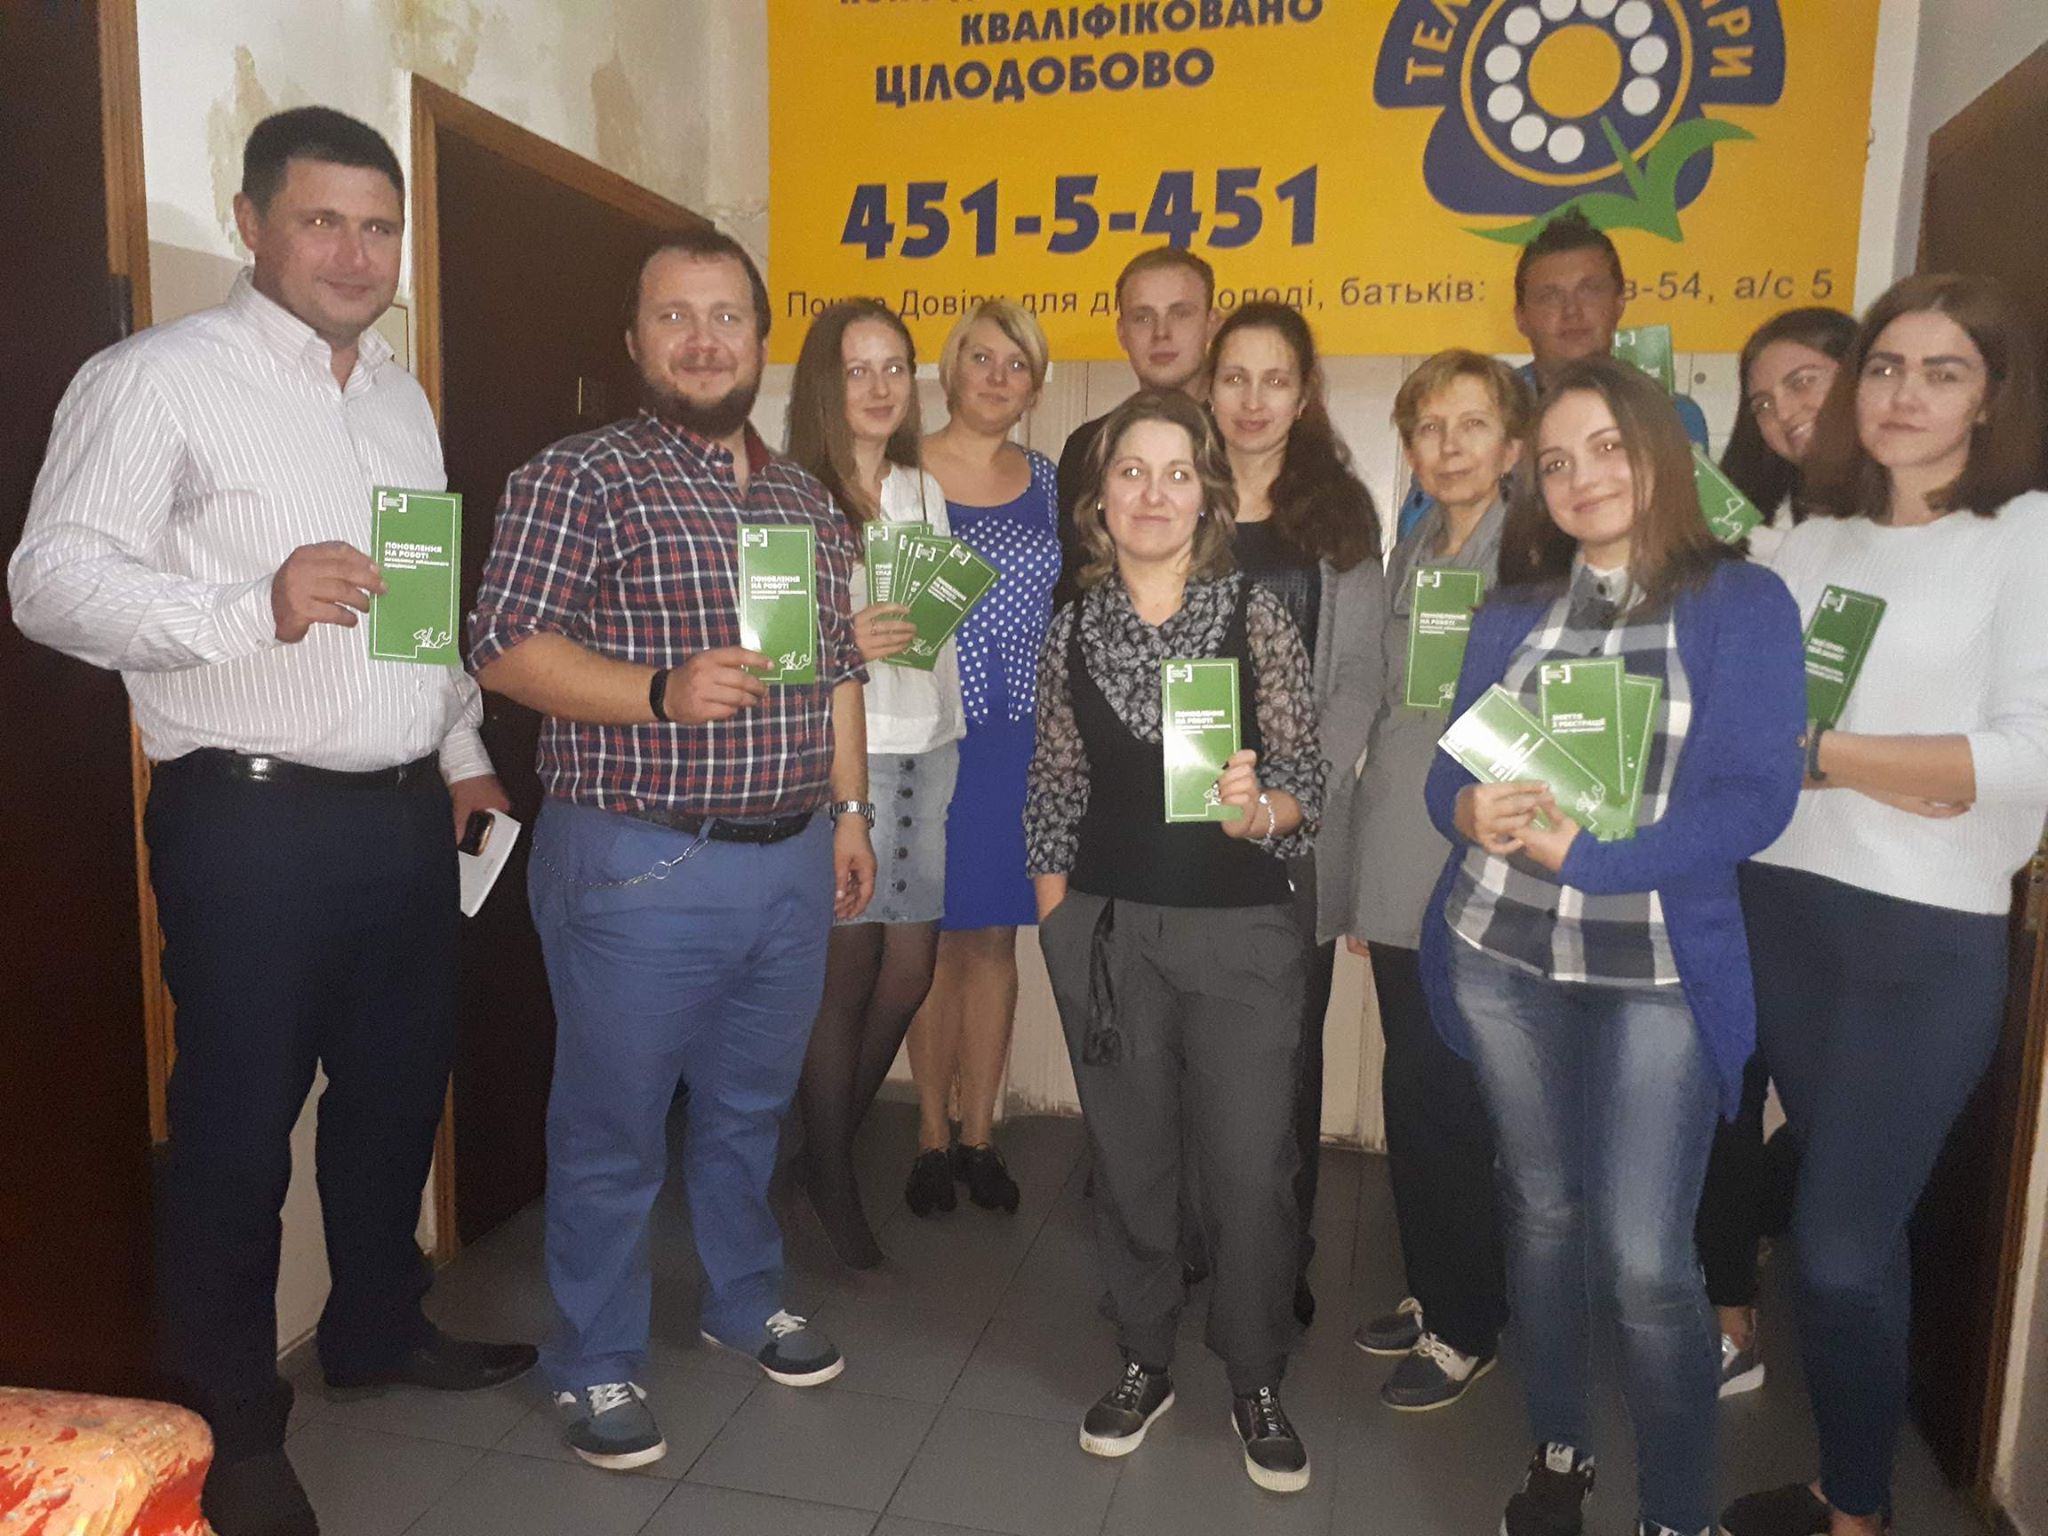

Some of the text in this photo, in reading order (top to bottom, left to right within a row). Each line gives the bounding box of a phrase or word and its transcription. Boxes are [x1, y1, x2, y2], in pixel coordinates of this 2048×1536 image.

[961, 0, 1322, 46] КВАЛІФІКОВАНО
[876, 48, 1215, 108] ЦІЛОДОБОВО
[839, 163, 1318, 260] 451-5-451
[1022, 291, 1077, 317] для
[1341, 273, 1487, 307] батьків:
[1734, 268, 1793, 300] а/с
[1811, 267, 1835, 301] 5
